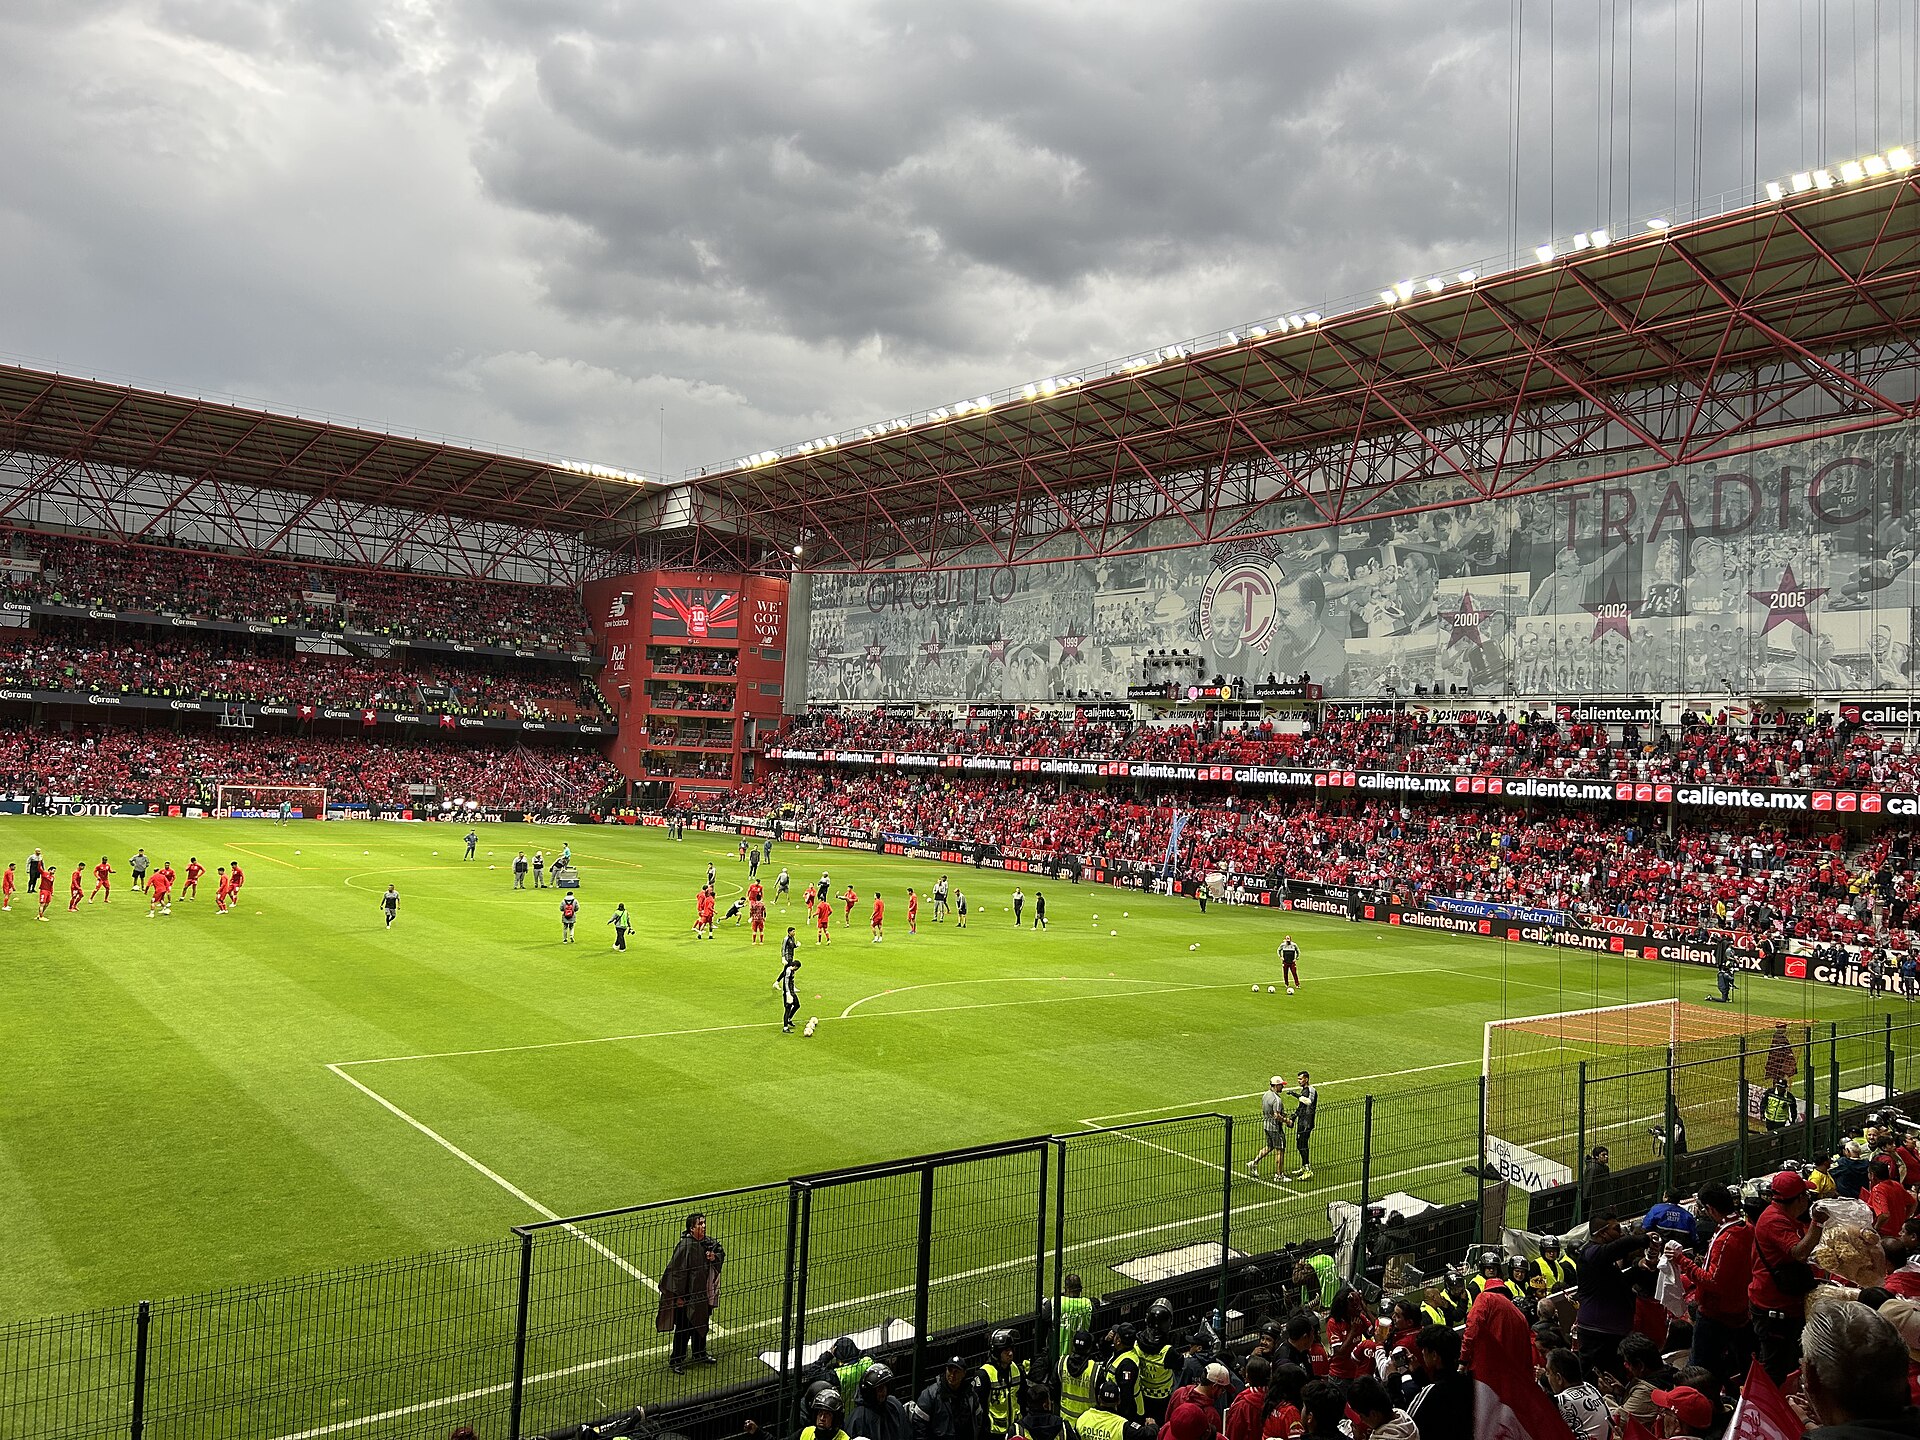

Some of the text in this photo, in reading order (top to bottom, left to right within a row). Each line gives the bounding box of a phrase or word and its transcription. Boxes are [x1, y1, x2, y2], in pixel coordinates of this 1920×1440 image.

[867, 566, 1017, 613] ORGULLO
[3, 601, 31, 611] Corona
[1770, 591, 1806, 609] 2005
[757, 600, 778, 613] WE
[1597, 603, 1628, 619] 2002
[89, 609, 116, 619] Corona
[692, 611, 705, 621] 10
[754, 613, 781, 625] GOT
[1454, 612, 1479, 627] 2000
[171, 617, 197, 626] Corona
[612, 619, 629, 628] balance
[249, 624, 273, 633] Corona
[754, 624, 781, 636] NOW
[321, 631, 344, 640] Corona
[389, 638, 411, 646] Corona
[453, 644, 475, 652] Corona
[1063, 636, 1078, 648] 1999
[611, 645, 626, 661] Red
[0, 689, 32, 700] Corona
[88, 694, 120, 704] Corona
[170, 700, 201, 710] Corona
[260, 705, 288, 714] Corona
[324, 709, 350, 718] Corona
[394, 713, 419, 722] Corona
[1083, 706, 1130, 719] calientemx
[1573, 706, 1661, 721] caliente.mx
[460, 717, 484, 727] Corona
[522, 721, 546, 730] Corona
[580, 724, 602, 733] Corona
[781, 750, 817, 760] caliente.mx
[836, 751, 875, 762] caliente.mx
[896, 752, 939, 766] caliente.mx
[962, 756, 1012, 770] caliente.mx
[1040, 760, 1098, 774] caliente.mx
[1130, 763, 1197, 779] caliente.mx
[1234, 767, 1313, 785] caliente.mx
[1358, 773, 1451, 792] caliente.mx
[1505, 779, 1613, 800] caliente.mx
[1676, 786, 1808, 810] caliente.mx
[1324, 888, 1349, 899] volari
[1441, 900, 1485, 916] Electrolit
[1402, 911, 1477, 933] caliente.mx
[1607, 921, 1635, 936] Cola
[1521, 925, 1607, 950] calnte.mx
[1660, 944, 1762, 971] calienmx
[1489, 1141, 1511, 1158] LIGA
[1500, 1159, 1543, 1190] BBVA
[1083, 1426, 1111, 1439] POLICIA
